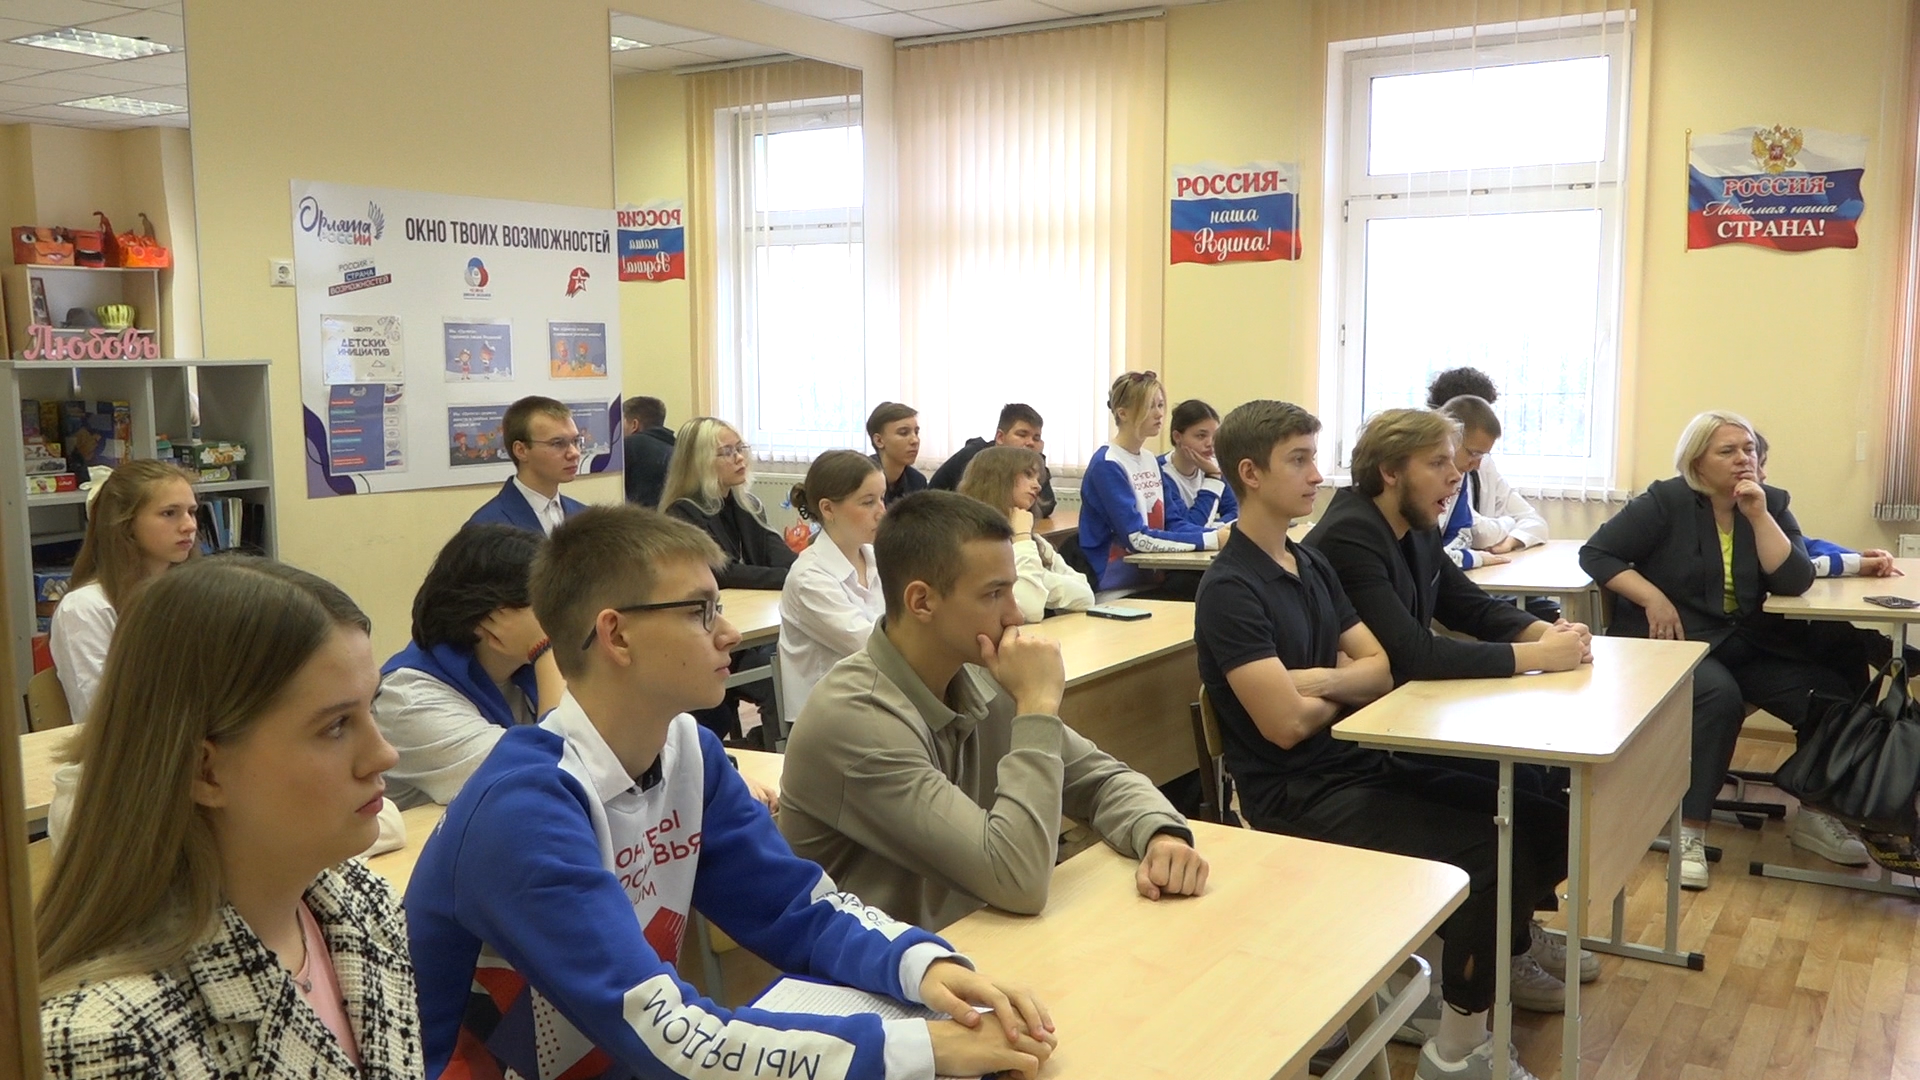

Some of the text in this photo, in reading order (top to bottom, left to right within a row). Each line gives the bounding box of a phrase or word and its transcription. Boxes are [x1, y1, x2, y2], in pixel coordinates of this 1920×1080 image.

[1177, 171, 1287, 197] РОССИЯ-
[1723, 176, 1834, 197] РОССИЯ-
[299, 196, 371, 237] Орлята
[1210, 208, 1259, 224] наша
[1703, 199, 1838, 217] Любимая наша
[405, 217, 611, 253] ОКНО ТВОИХ ВОЗМОЖНОСТЕЙ
[1717, 219, 1826, 238] СТРАНА!
[1194, 227, 1271, 261] Родина!
[345, 268, 375, 282] СТРАНА
[23, 324, 158, 360] Любовь
[337, 347, 391, 356] ИНИЦИАТИВ
[341, 339, 387, 348] ДЕТСКИХ
[643, 988, 821, 1080] МЫ РЯДОМ
